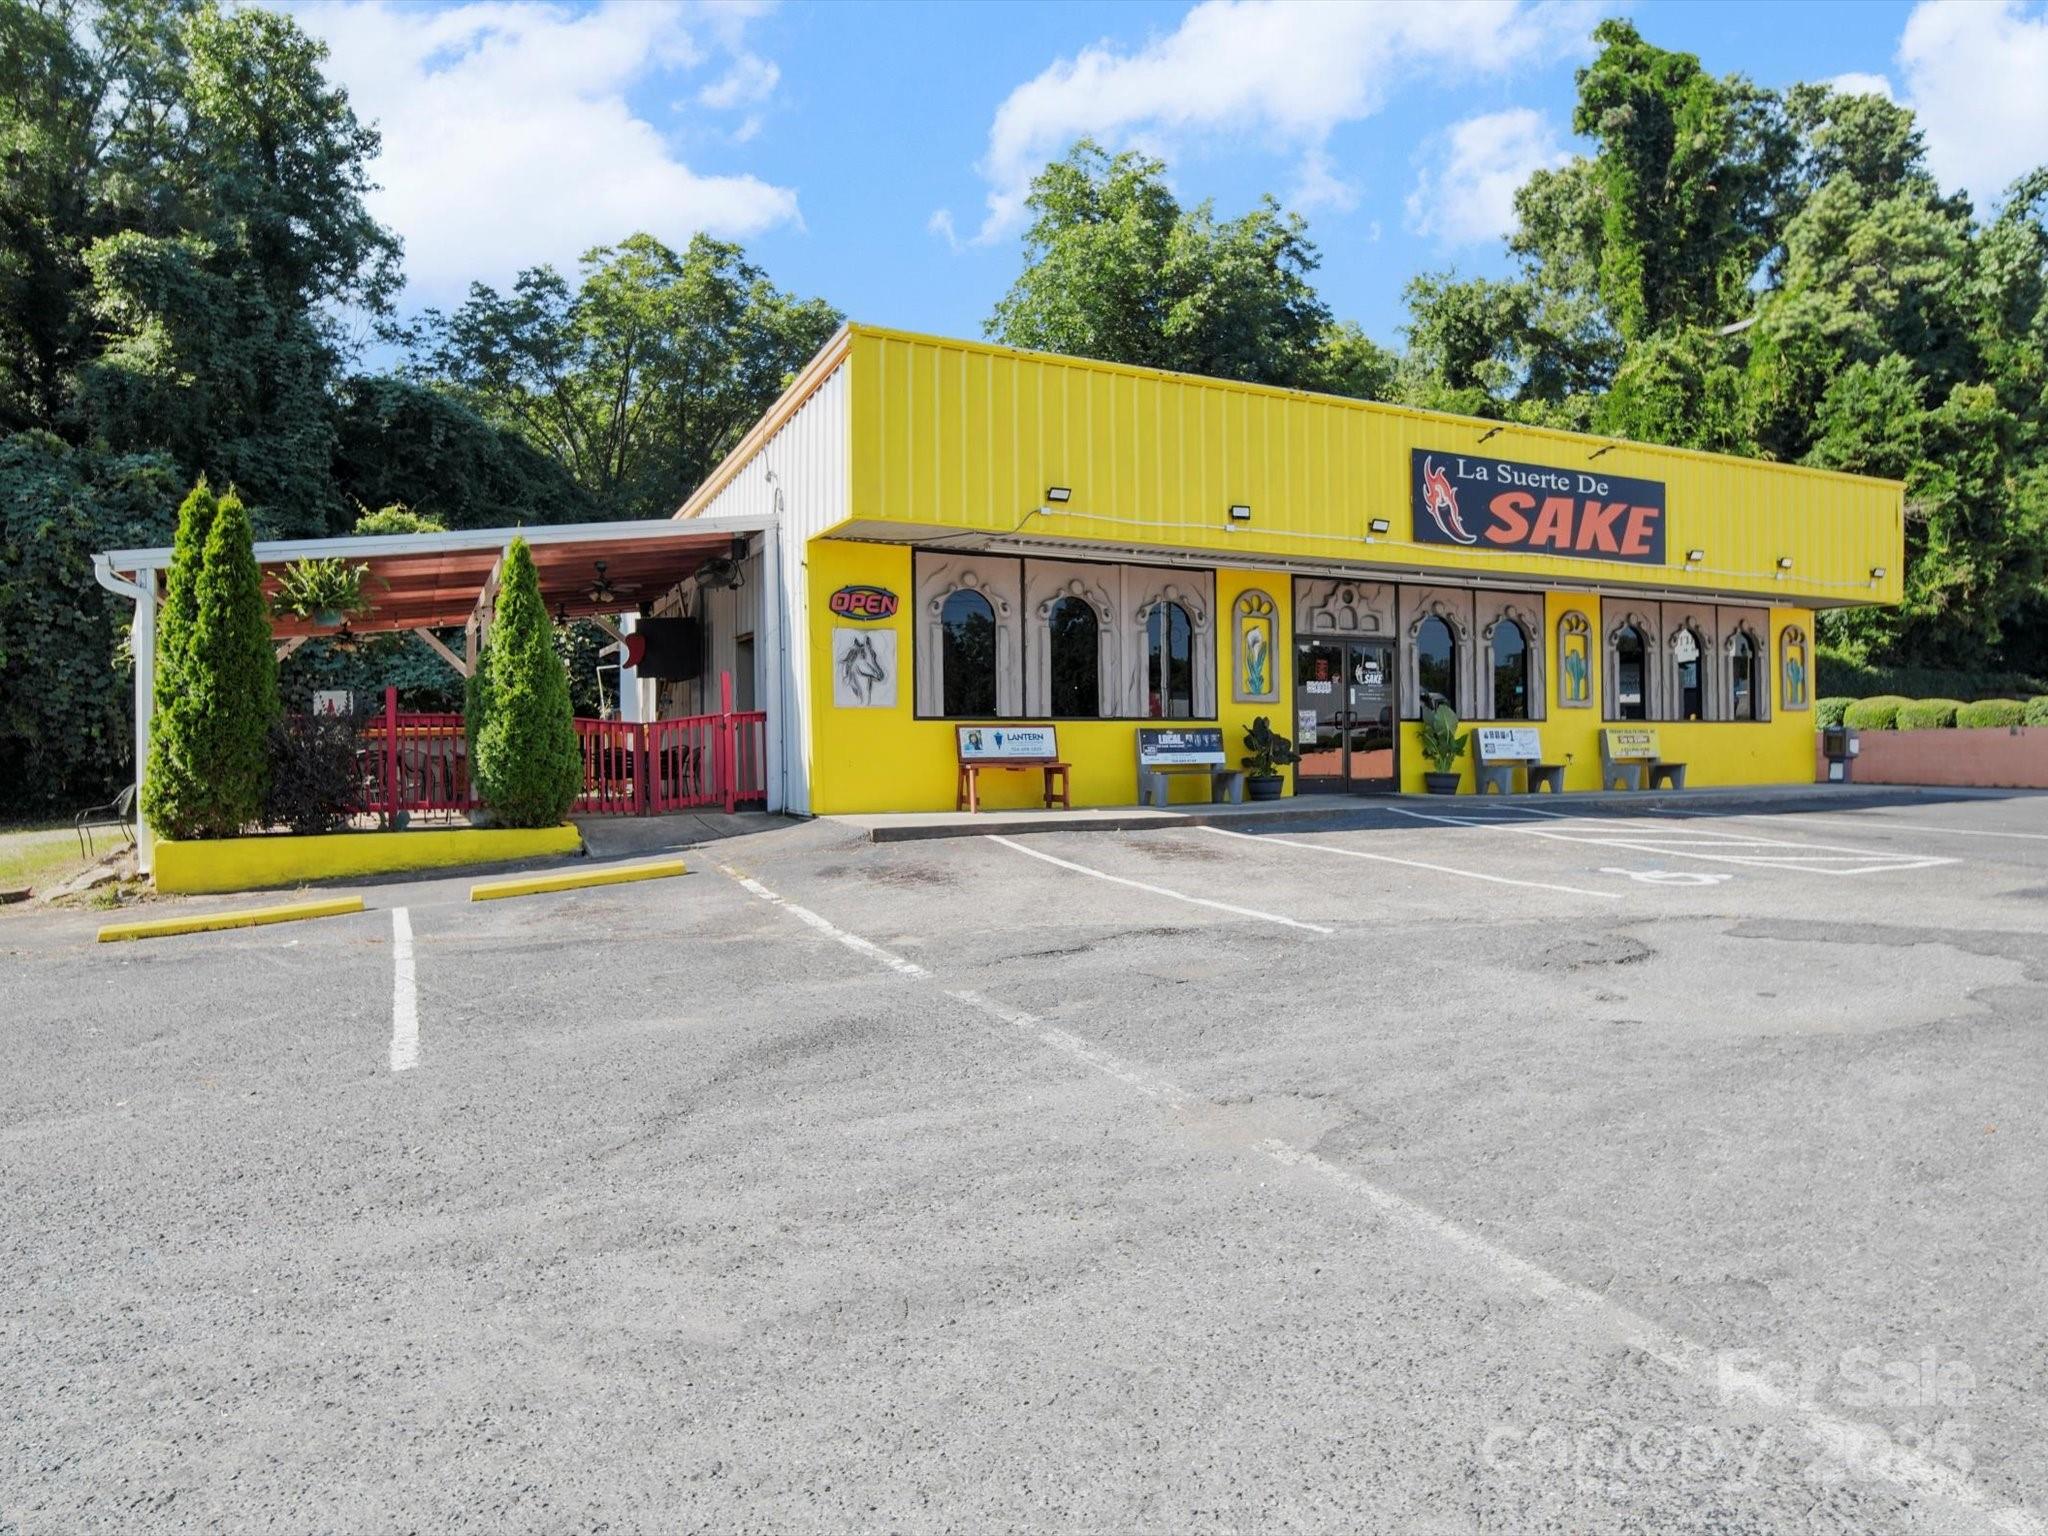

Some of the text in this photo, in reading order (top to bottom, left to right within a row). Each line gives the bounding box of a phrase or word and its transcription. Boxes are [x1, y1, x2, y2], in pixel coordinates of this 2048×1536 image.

[1456, 458, 1609, 496] La Suerte De
[1484, 491, 1660, 556] SAKE
[831, 591, 899, 616] OPEN
[1364, 674, 1383, 684] SAKE
[1006, 733, 1045, 742] LANTERN
